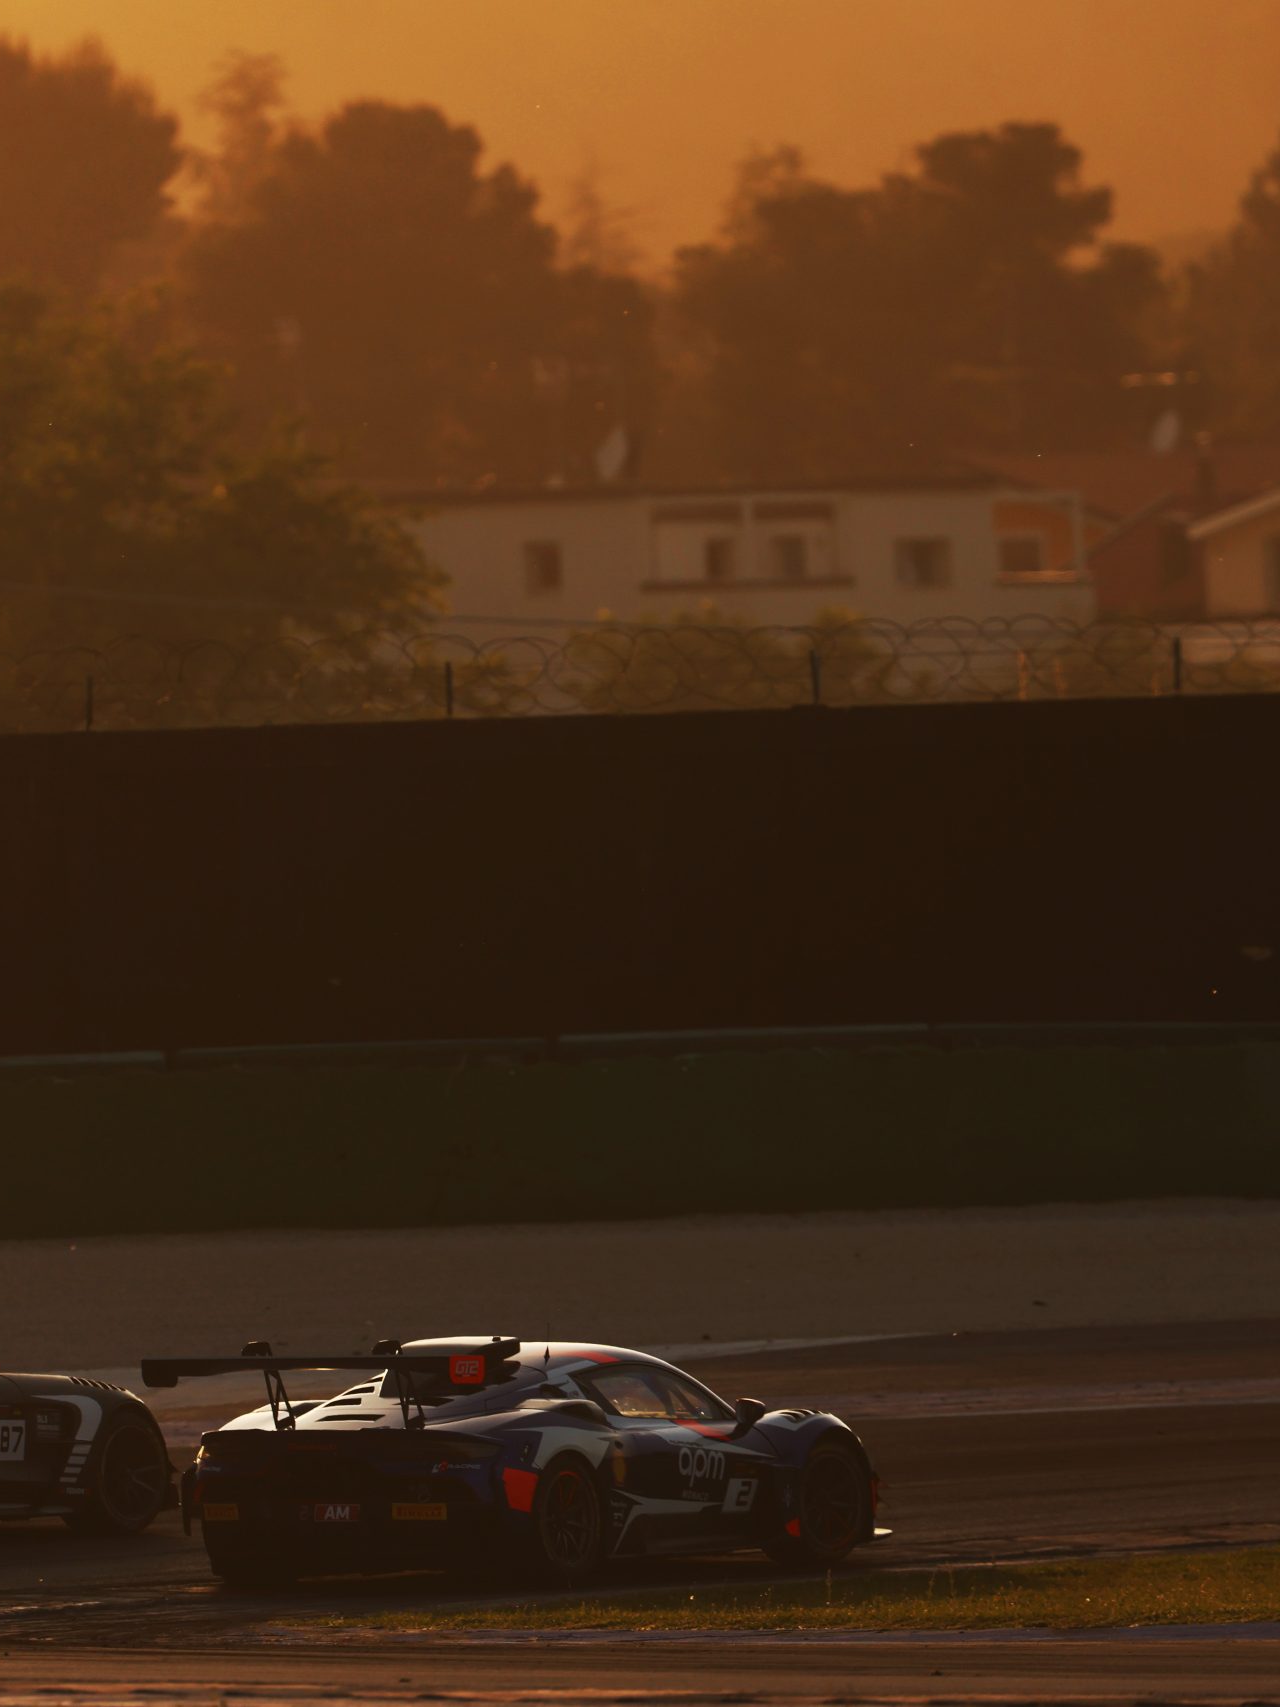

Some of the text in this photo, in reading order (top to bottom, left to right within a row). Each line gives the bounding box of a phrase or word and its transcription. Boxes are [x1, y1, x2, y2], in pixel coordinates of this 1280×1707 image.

[455, 1359, 480, 1377] GT2
[0, 1426, 24, 1453] 87
[678, 1447, 726, 1487] apm
[735, 1480, 755, 1507] 2
[324, 1506, 350, 1520] AM
